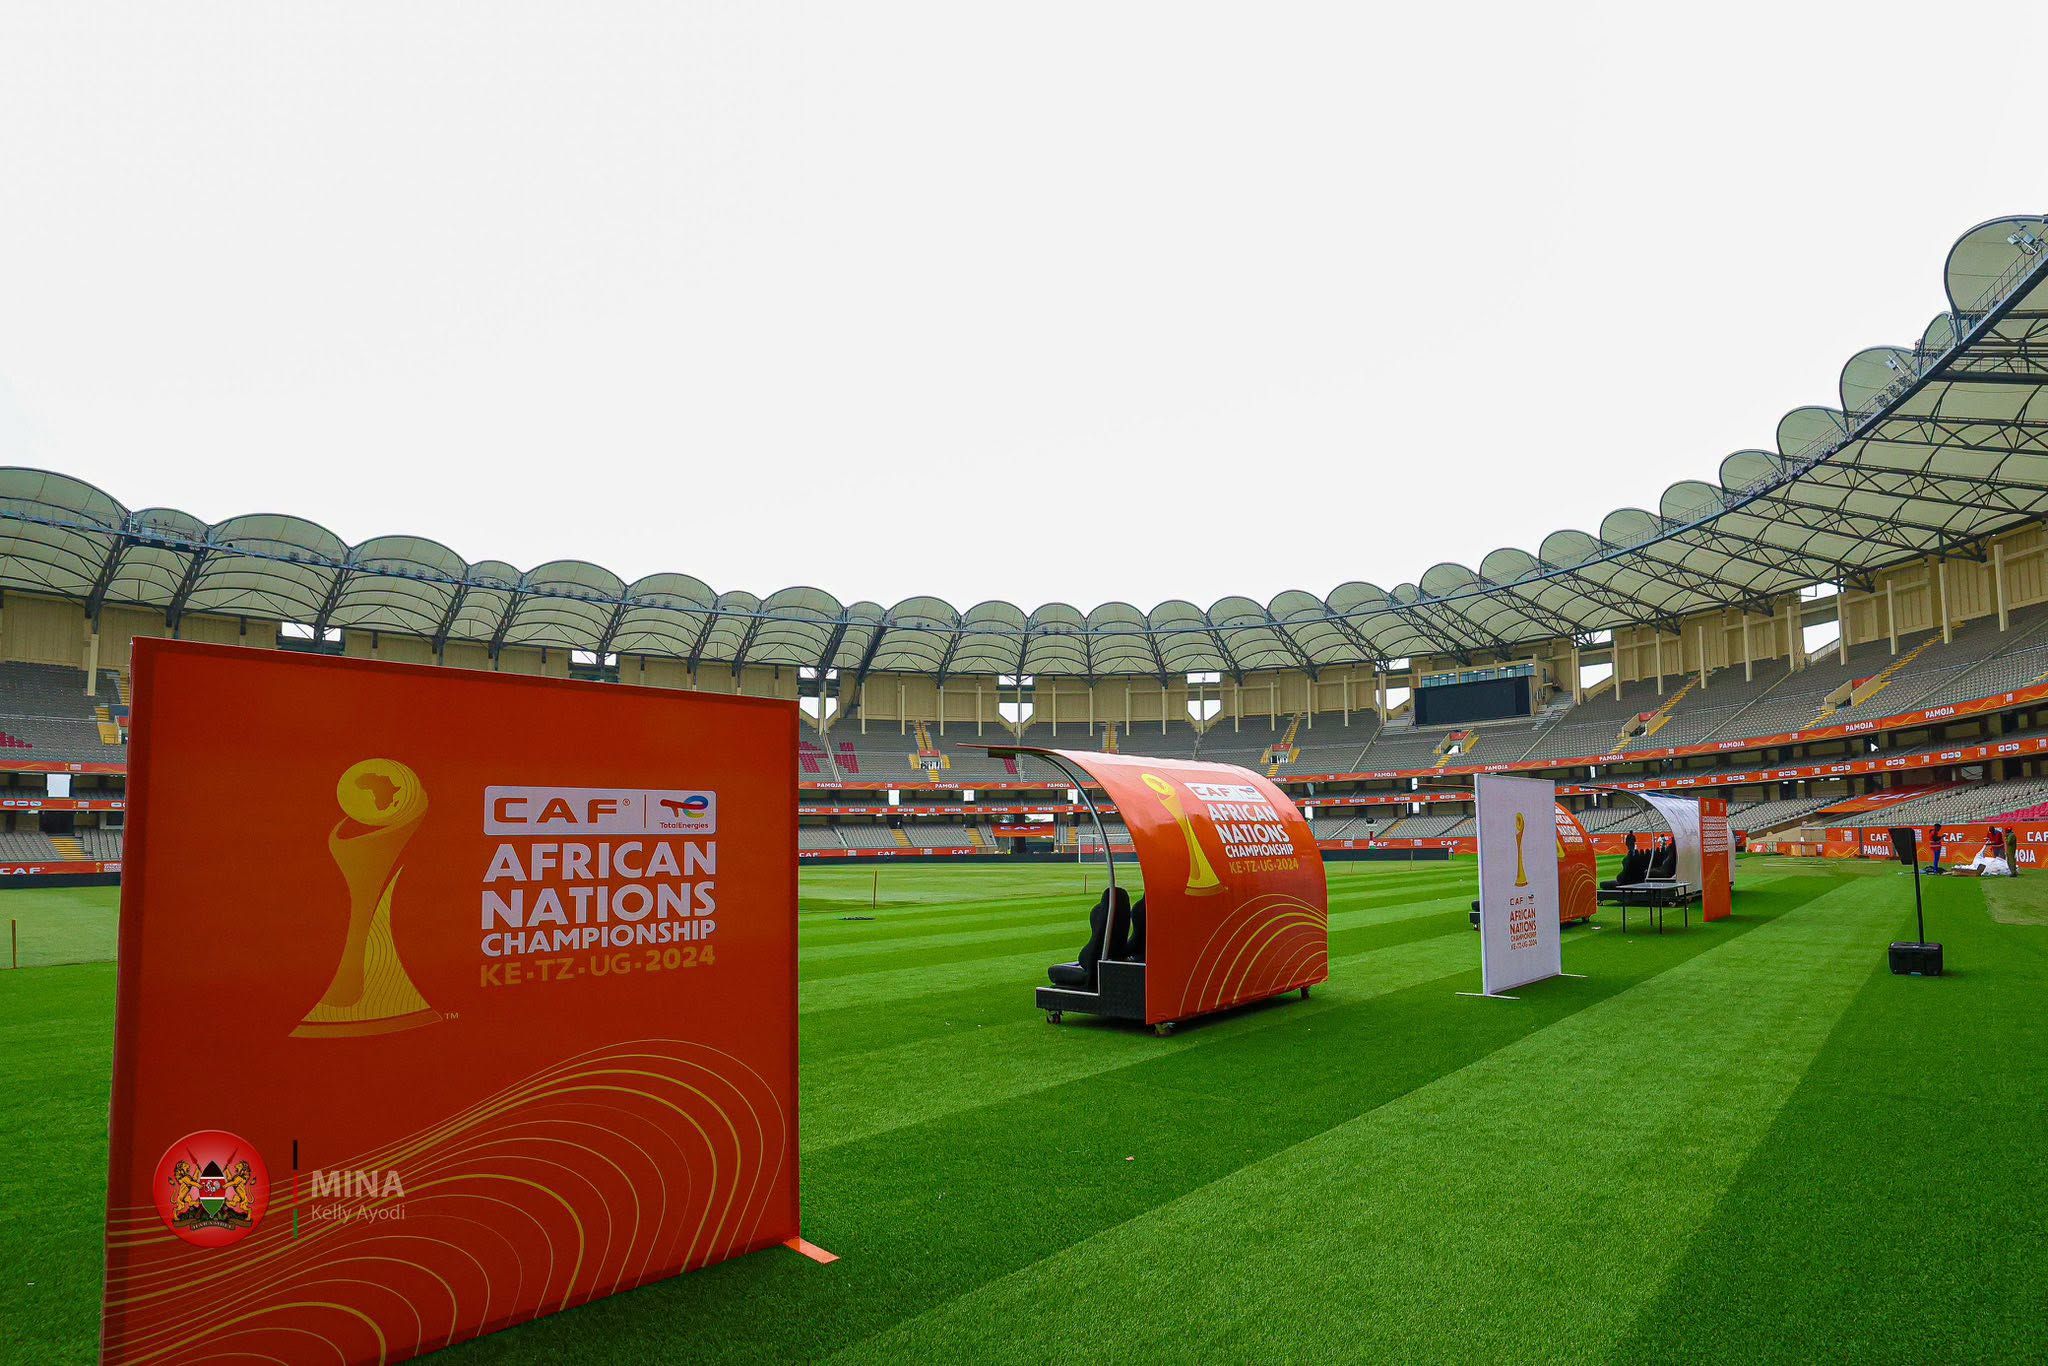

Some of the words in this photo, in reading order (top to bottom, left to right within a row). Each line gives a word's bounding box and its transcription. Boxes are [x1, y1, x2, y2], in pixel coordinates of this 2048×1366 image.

[1925, 707, 1954, 718] PAMOJA
[1845, 722, 1874, 732] PAMOJA
[1719, 741, 1745, 749] PAMOJA
[1207, 803, 1280, 822] AFRICAN
[659, 821, 709, 830] TotalEnergies
[1215, 823, 1290, 844] NATIONS
[1870, 833, 1887, 841] CAF
[1225, 843, 1294, 858] CHAMPIONSHIP
[1863, 845, 1890, 856] PAMOJA
[482, 841, 717, 883] AFRICAN
[480, 881, 717, 930] NATIONS
[1510, 907, 1536, 921] AFRICAN
[1510, 920, 1537, 934] NATIONS
[480, 919, 717, 957] CHAMPIONSHIP
